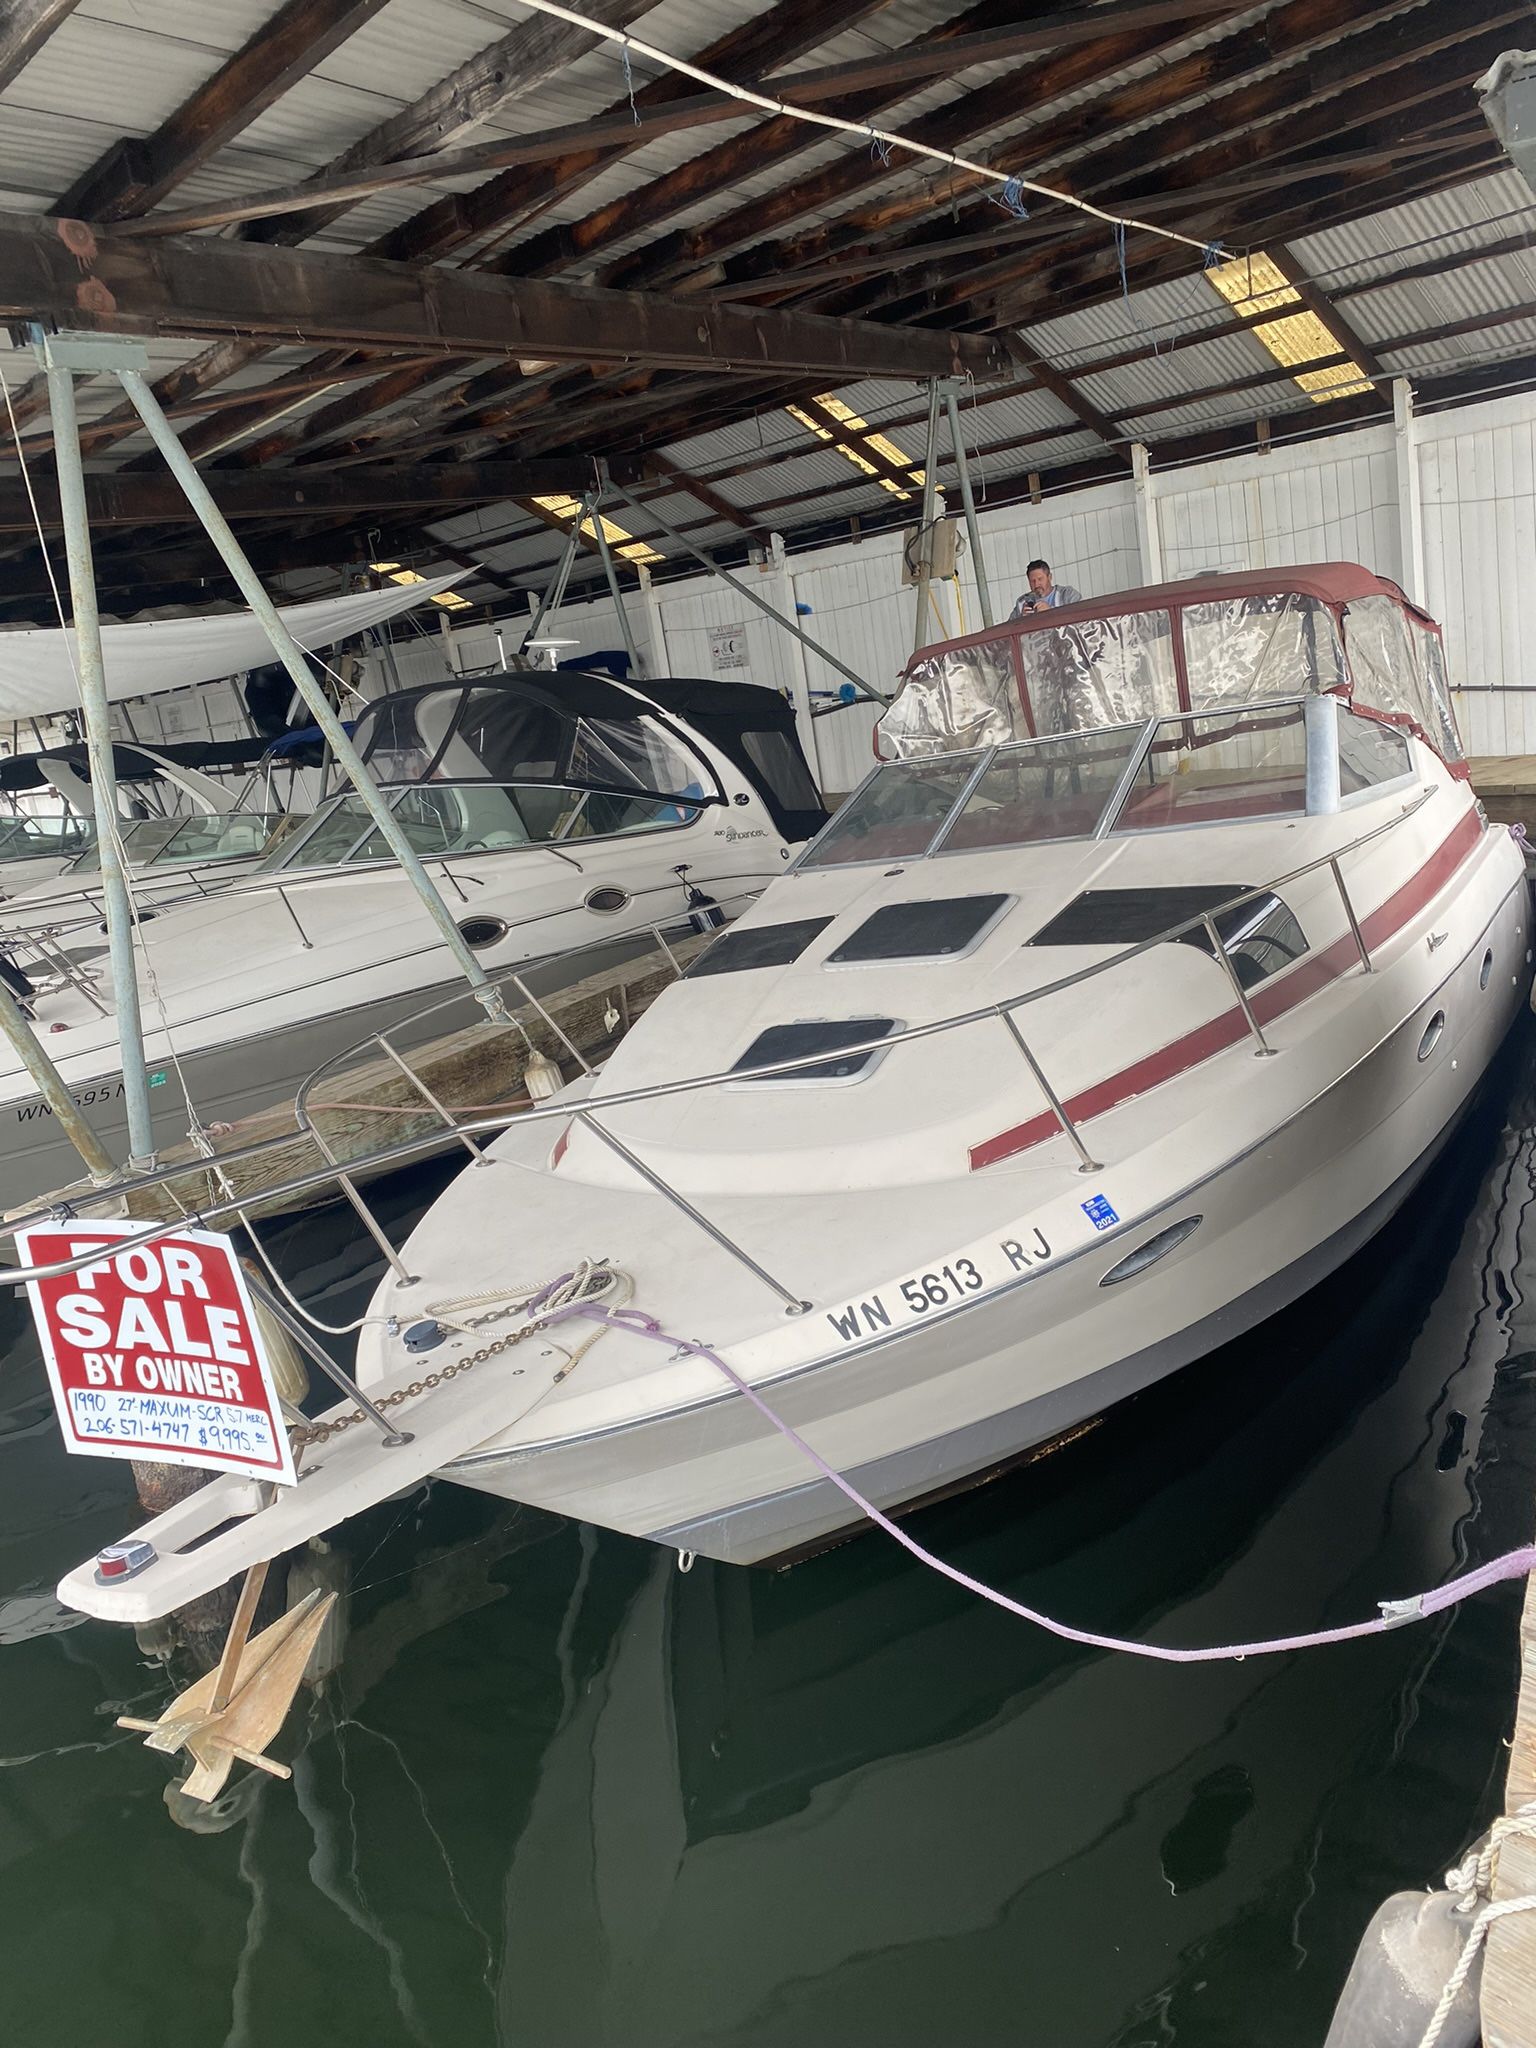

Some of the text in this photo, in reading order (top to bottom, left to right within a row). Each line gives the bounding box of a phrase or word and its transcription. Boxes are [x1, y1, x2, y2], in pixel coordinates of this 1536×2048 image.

[1095, 1213, 1118, 1229] 2021
[70, 1242, 211, 1300] FOR
[827, 1227, 1052, 1342] WN 5613 RJ
[56, 1294, 250, 1366] SALE
[74, 1392, 106, 1412] 1990
[83, 1353, 244, 1401] BY OWNER
